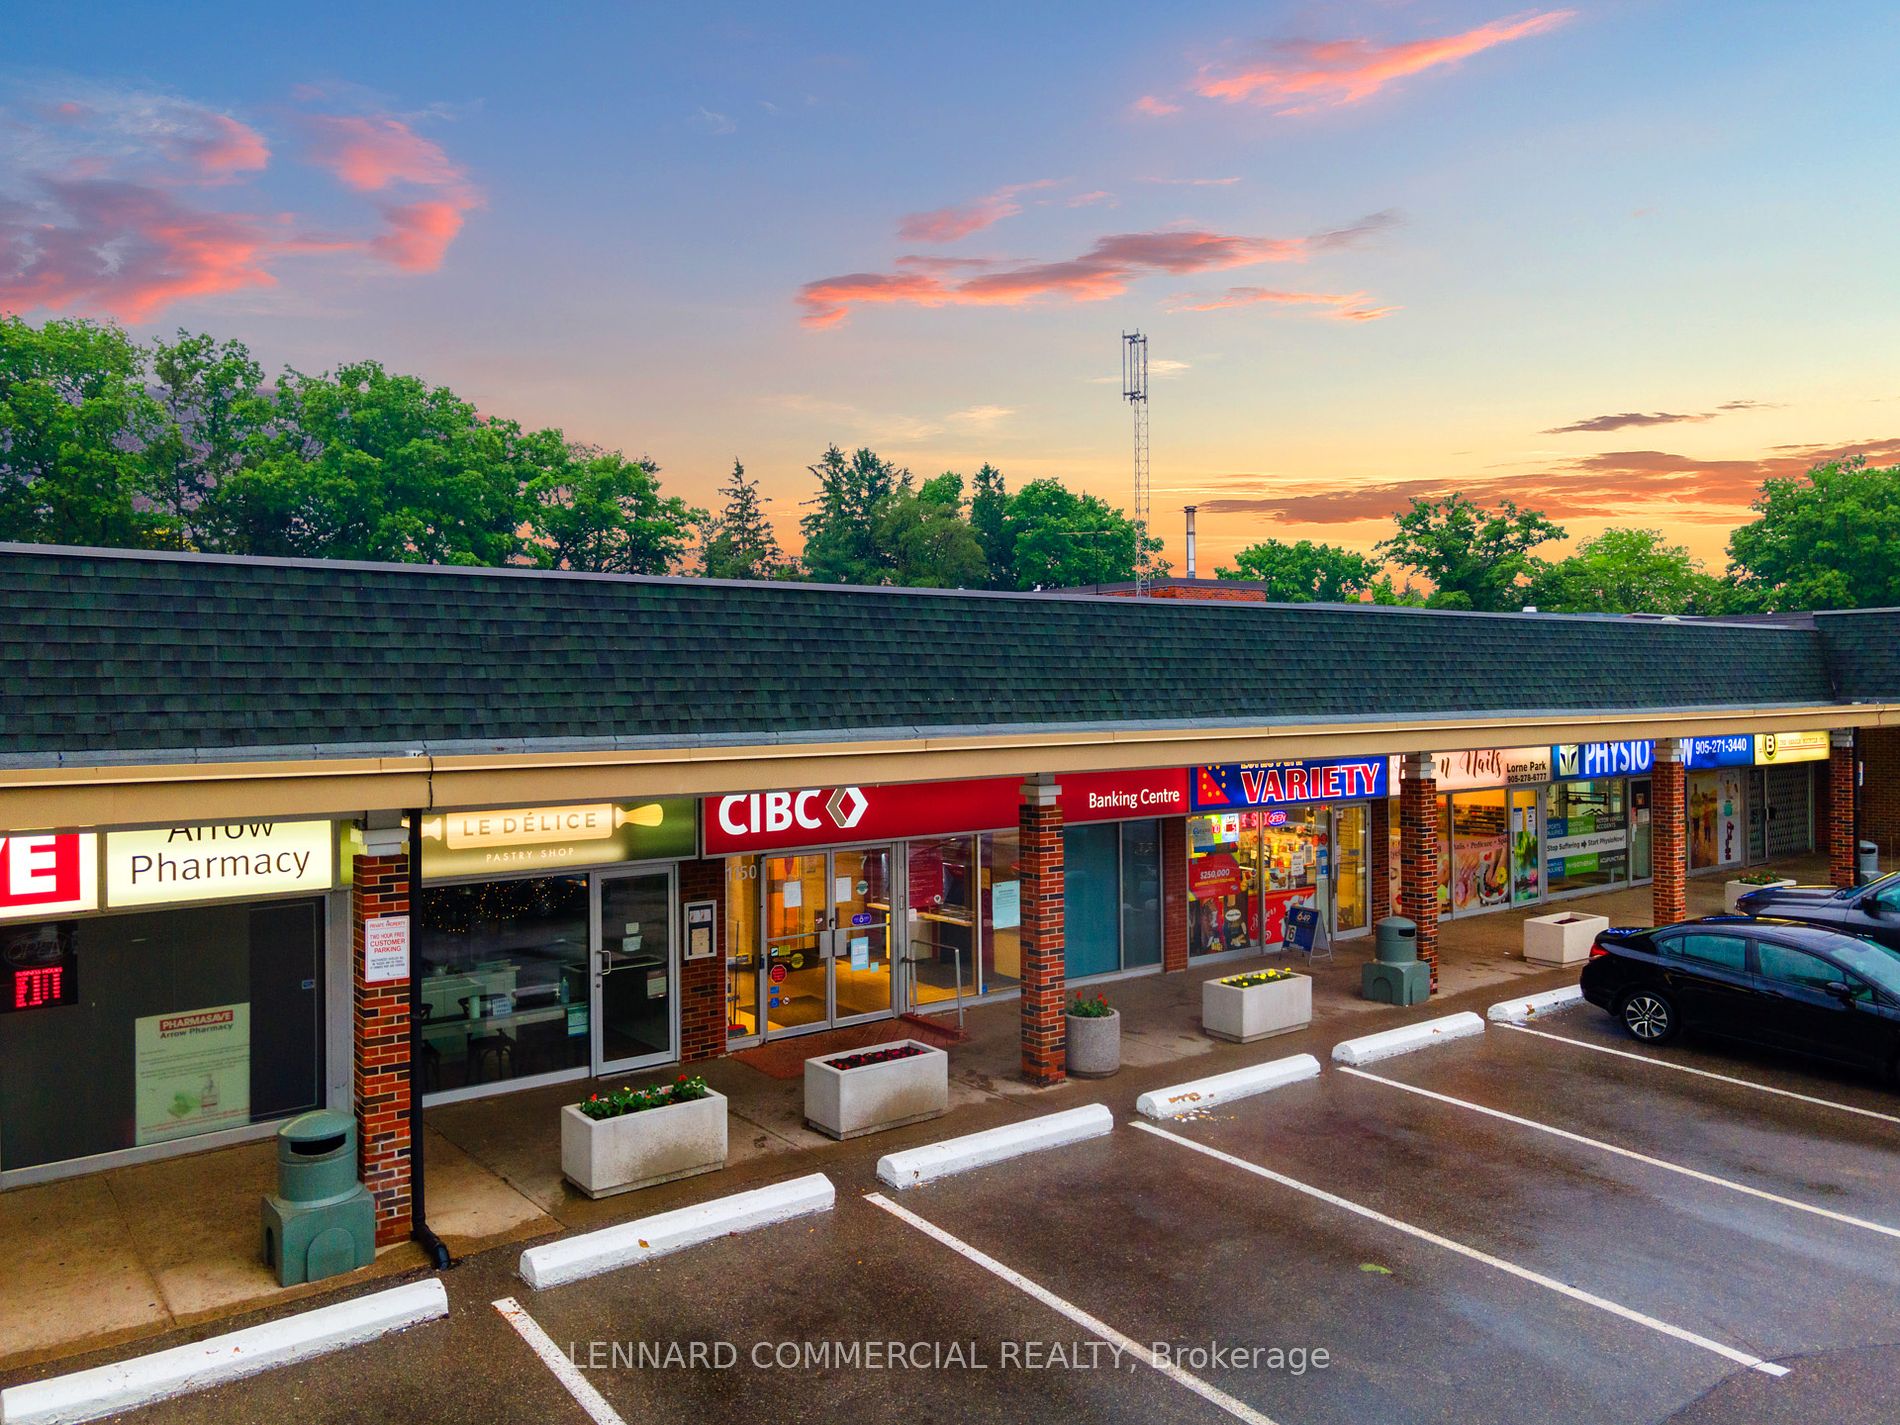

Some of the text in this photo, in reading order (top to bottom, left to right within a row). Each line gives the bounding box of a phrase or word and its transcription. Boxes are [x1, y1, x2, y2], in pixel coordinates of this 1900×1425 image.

[1696, 738, 1747, 755] 905-271-3440
[1460, 750, 1503, 779] Nails
[1506, 760, 1547, 773] Lorne Park
[1240, 762, 1380, 804] VARIETY
[1089, 788, 1180, 809] Banking Centre
[718, 789, 822, 835] CIBC
[463, 812, 597, 836] LE DÉLICE
[486, 847, 575, 863] PASTRY SHOP
[131, 850, 310, 885] Pharmacy
[726, 865, 758, 881] 1150
[1200, 868, 1230, 880] $250,000
[370, 938, 405, 947] CUSTOMER
[374, 946, 402, 954] PARKING
[161, 1011, 232, 1030] PHARMASAVE
[160, 1023, 234, 1039] Arrow Pharmacy
